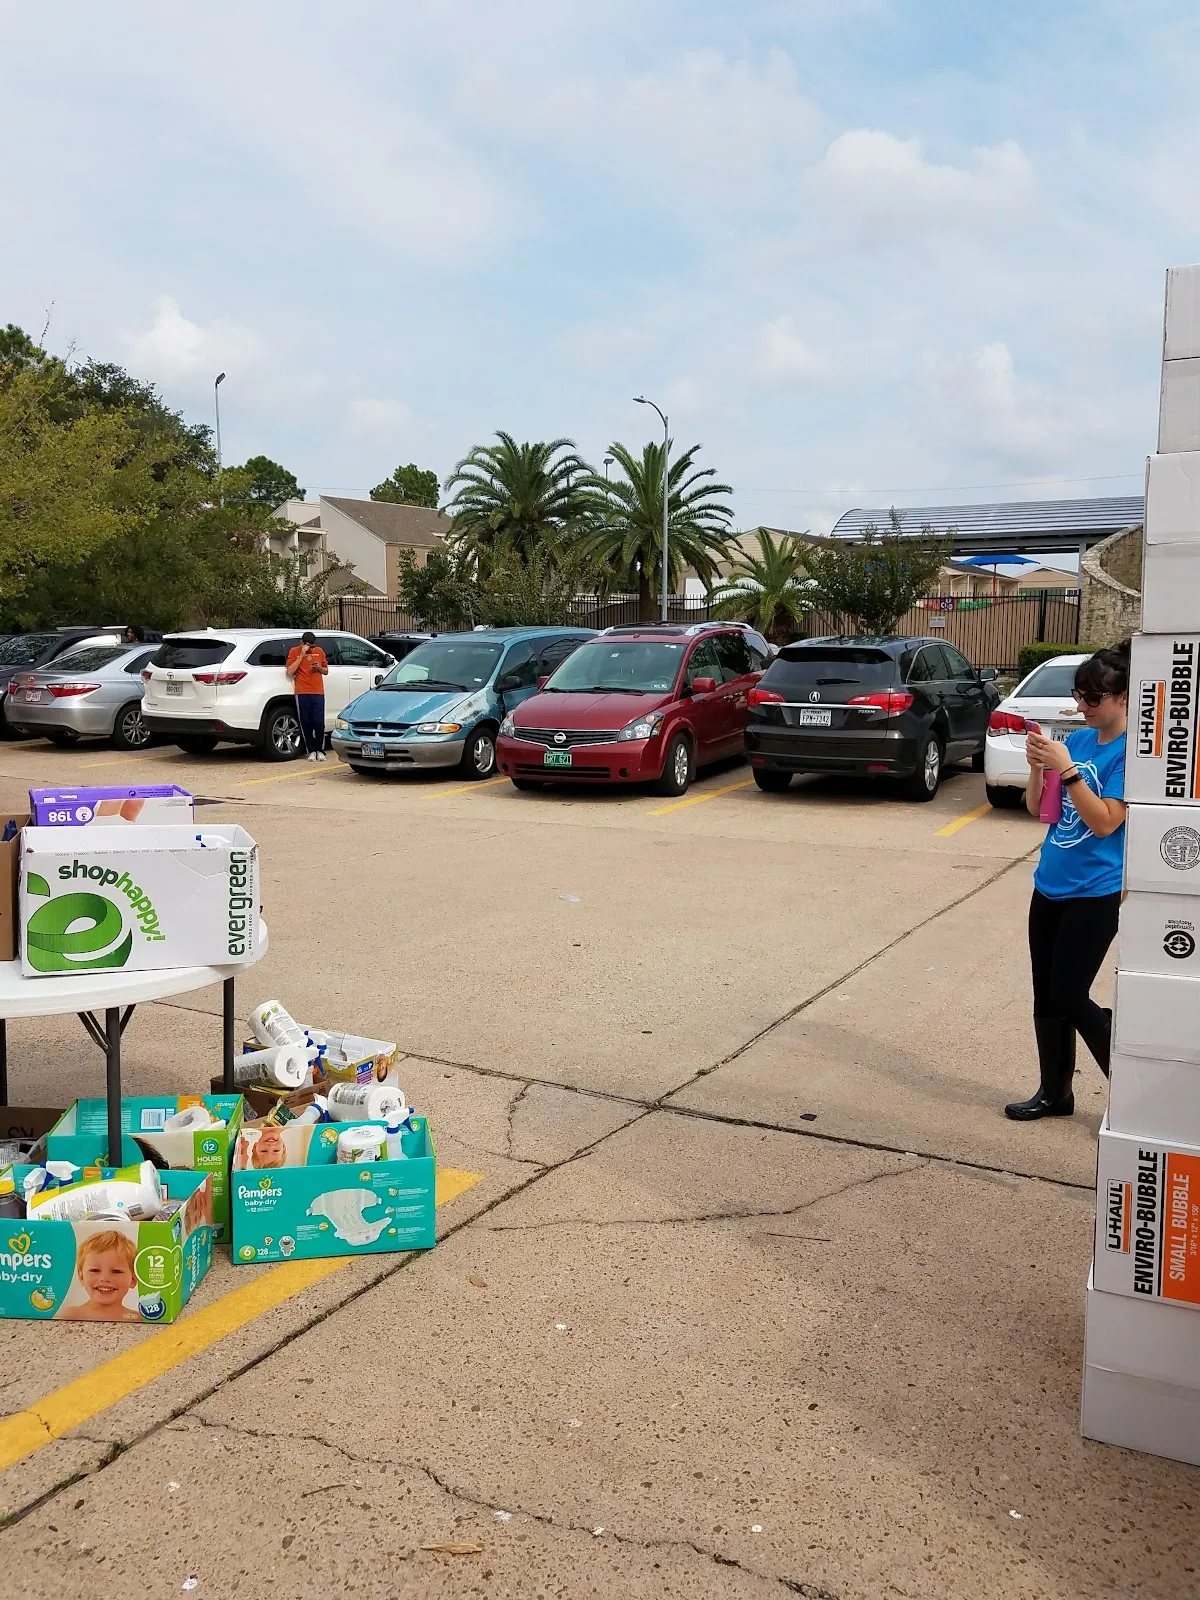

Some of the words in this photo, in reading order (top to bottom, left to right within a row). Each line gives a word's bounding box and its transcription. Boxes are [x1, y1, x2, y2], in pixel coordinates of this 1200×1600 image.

[1139, 682, 1157, 755] U-HAUL
[1165, 643, 1194, 798] ENVIRO-BUBBLE
[48, 811, 72, 822] 198
[81, 812, 88, 821] 3
[228, 851, 253, 956] evergreen
[204, 1143, 215, 1151] 12
[238, 1185, 283, 1200] Pampers
[244, 1199, 278, 1207] baby-dry
[1171, 1173, 1190, 1229] BUBBLE
[1108, 1183, 1124, 1250] U-HAUL
[1133, 1148, 1158, 1295] ENVIRO-BUBBLE
[243, 1247, 252, 1257] 6
[257, 1248, 269, 1256] 128
[1169, 1233, 1187, 1281] SMALL
[0, 1252, 52, 1271] mpers
[147, 1255, 165, 1268] 12
[0, 1271, 43, 1284] by-dry
[144, 1303, 161, 1314] 128
